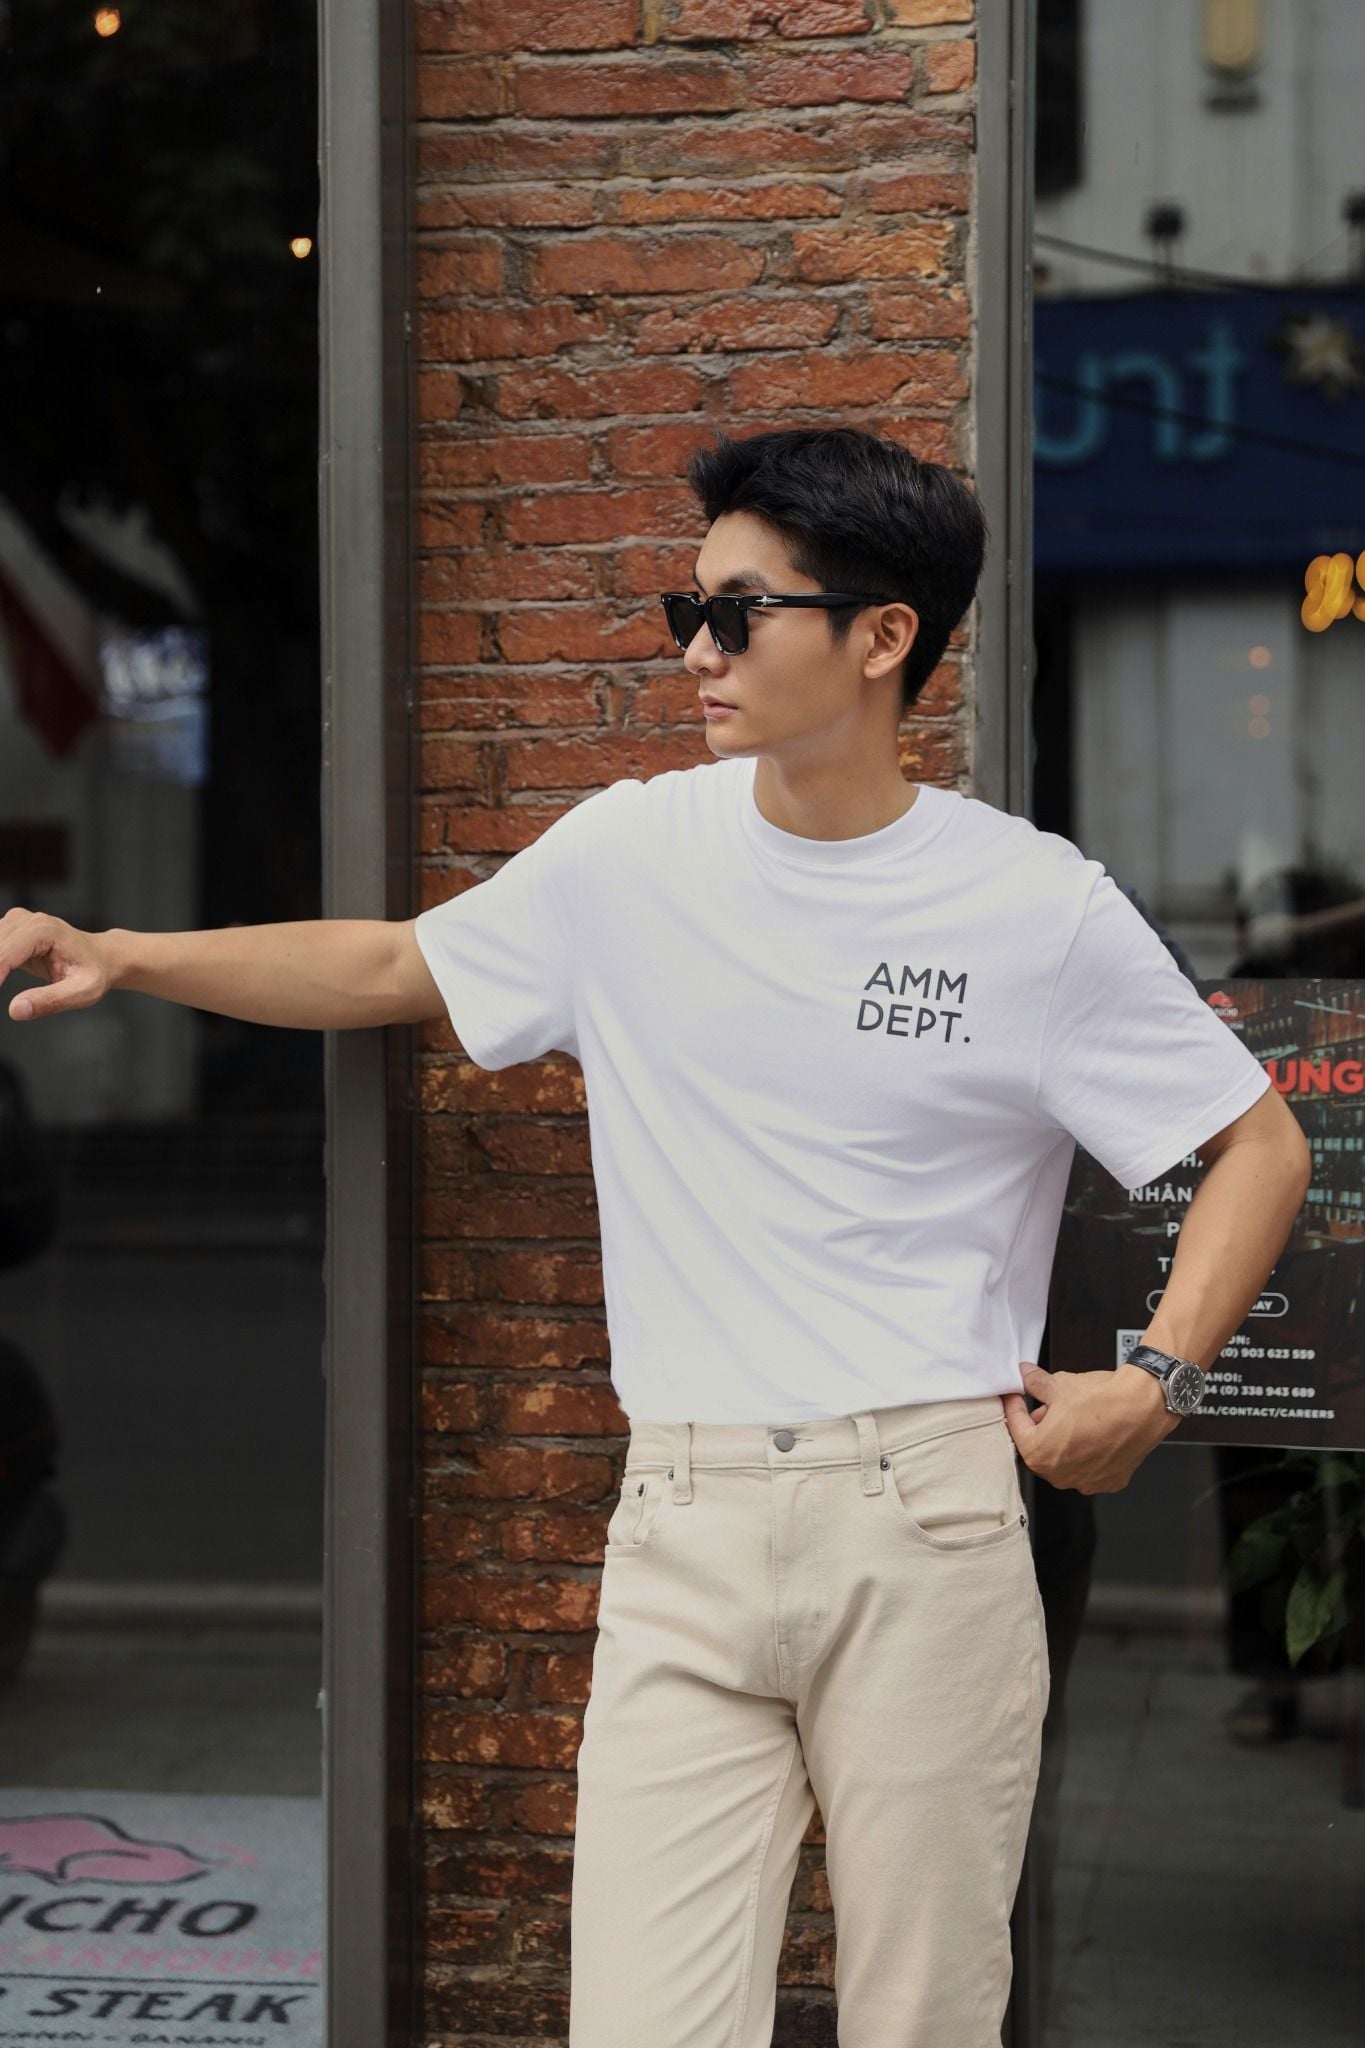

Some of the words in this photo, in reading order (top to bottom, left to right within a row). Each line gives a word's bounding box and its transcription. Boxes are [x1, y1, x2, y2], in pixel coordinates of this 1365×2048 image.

[864, 962, 968, 1004] AMM
[857, 999, 970, 1043] DEPT.
[1129, 1182, 1193, 1203] NHÂN
[28, 1987, 308, 2024] STEAK
